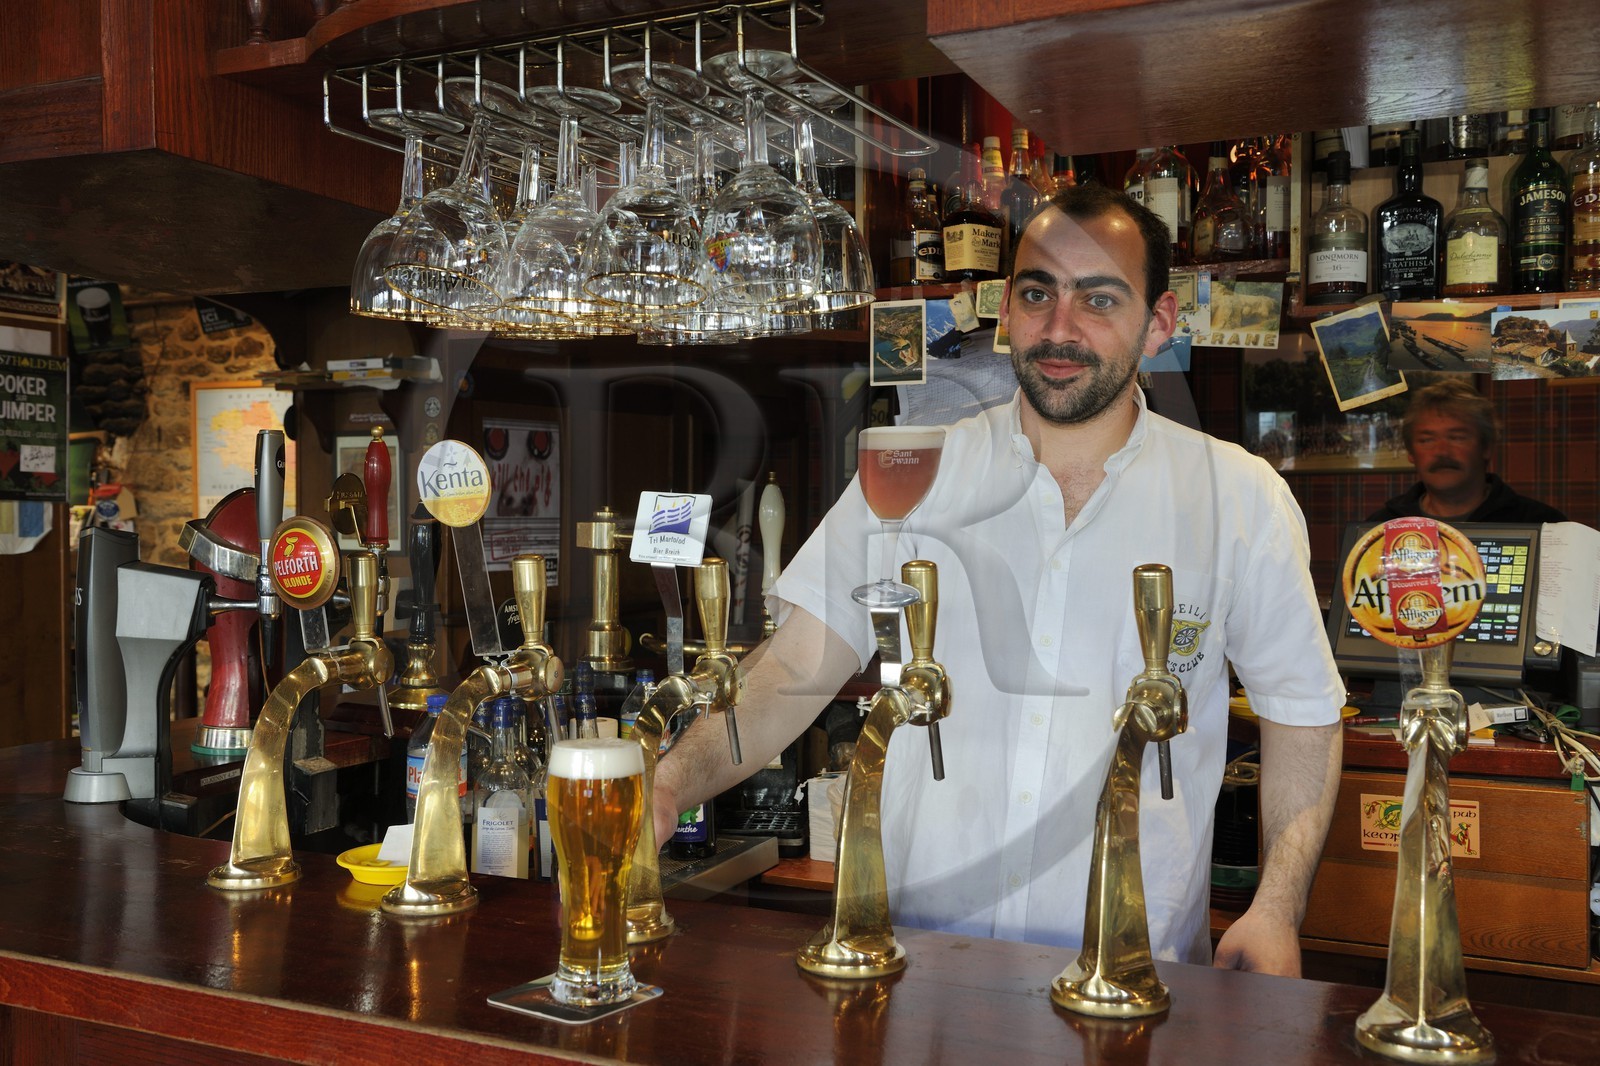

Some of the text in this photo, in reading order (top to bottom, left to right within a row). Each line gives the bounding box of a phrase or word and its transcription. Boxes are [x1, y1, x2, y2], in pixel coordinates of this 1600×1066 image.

[1519, 188, 1567, 207] JAMESON
[1316, 253, 1359, 262] LONGMORN
[1382, 259, 1434, 269] STRATHISLA
[513, 464, 530, 493] the
[273, 555, 319, 577] PELFORTH
[282, 573, 313, 589] BLONDE
[1398, 606, 1443, 621] Affligem
[1178, 651, 1205, 673] CLUB
[1453, 810, 1477, 819] pub
[482, 819, 514, 827] FRIGOLET
[675, 824, 699, 834] enthe
